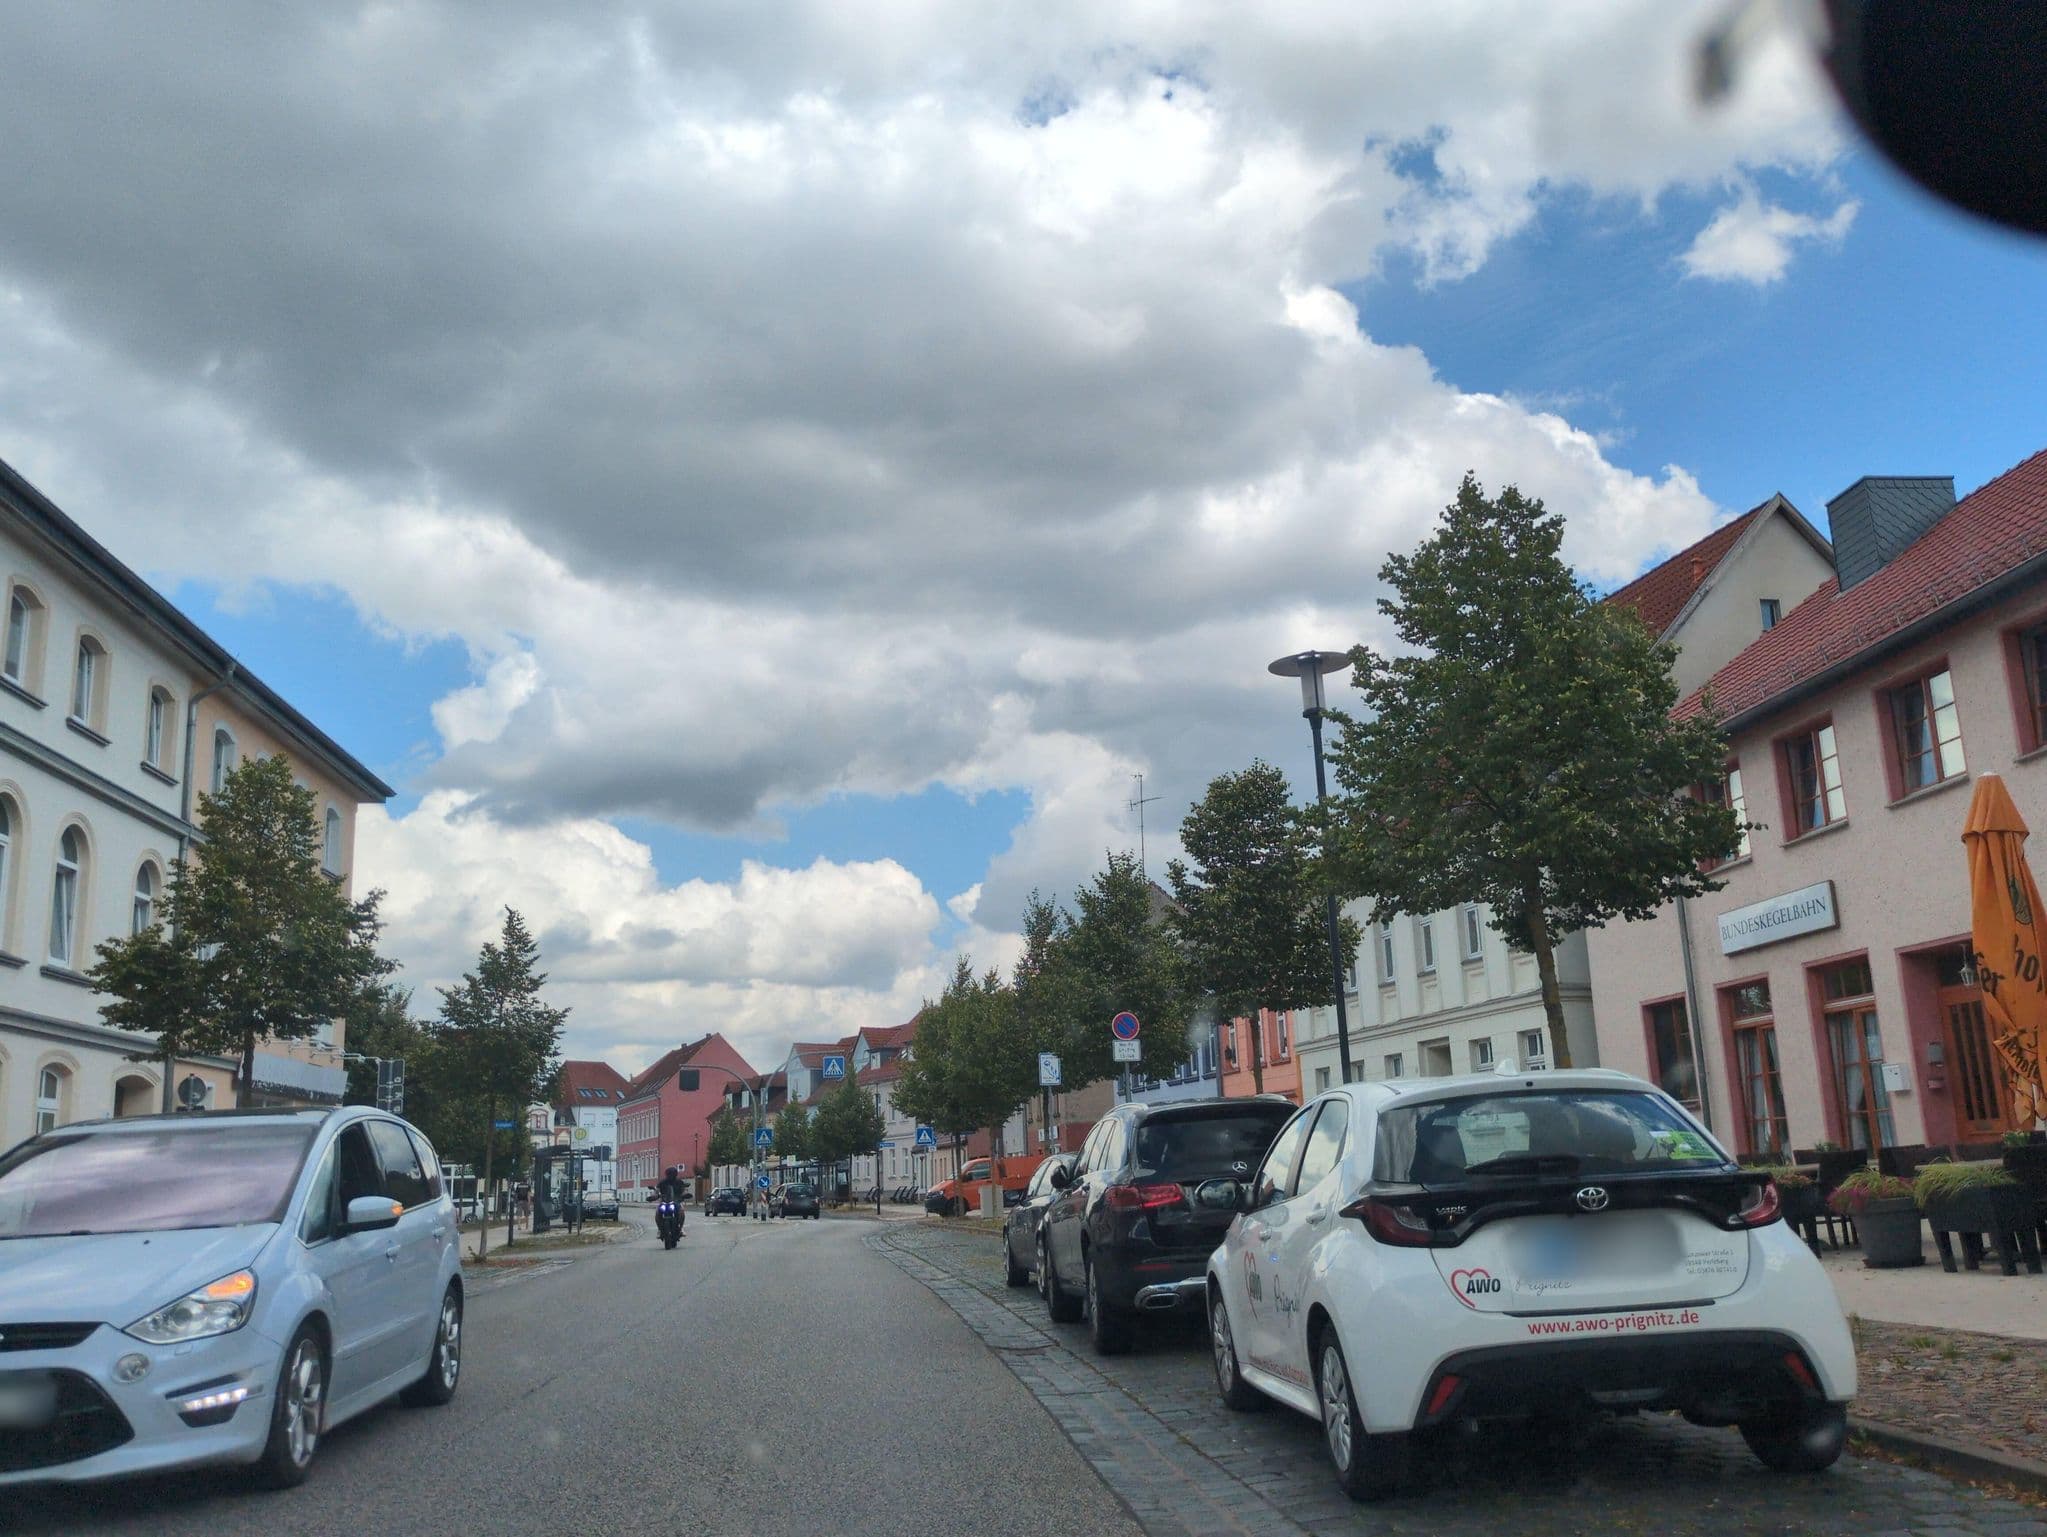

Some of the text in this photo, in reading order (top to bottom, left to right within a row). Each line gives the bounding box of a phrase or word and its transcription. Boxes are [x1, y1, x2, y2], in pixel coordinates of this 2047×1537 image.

[1721, 896, 1826, 941] BUNDESKEGELBAHN
[1466, 1278, 1501, 1294] AWO
[1528, 1310, 1700, 1335] www.awo-prignitz.de
